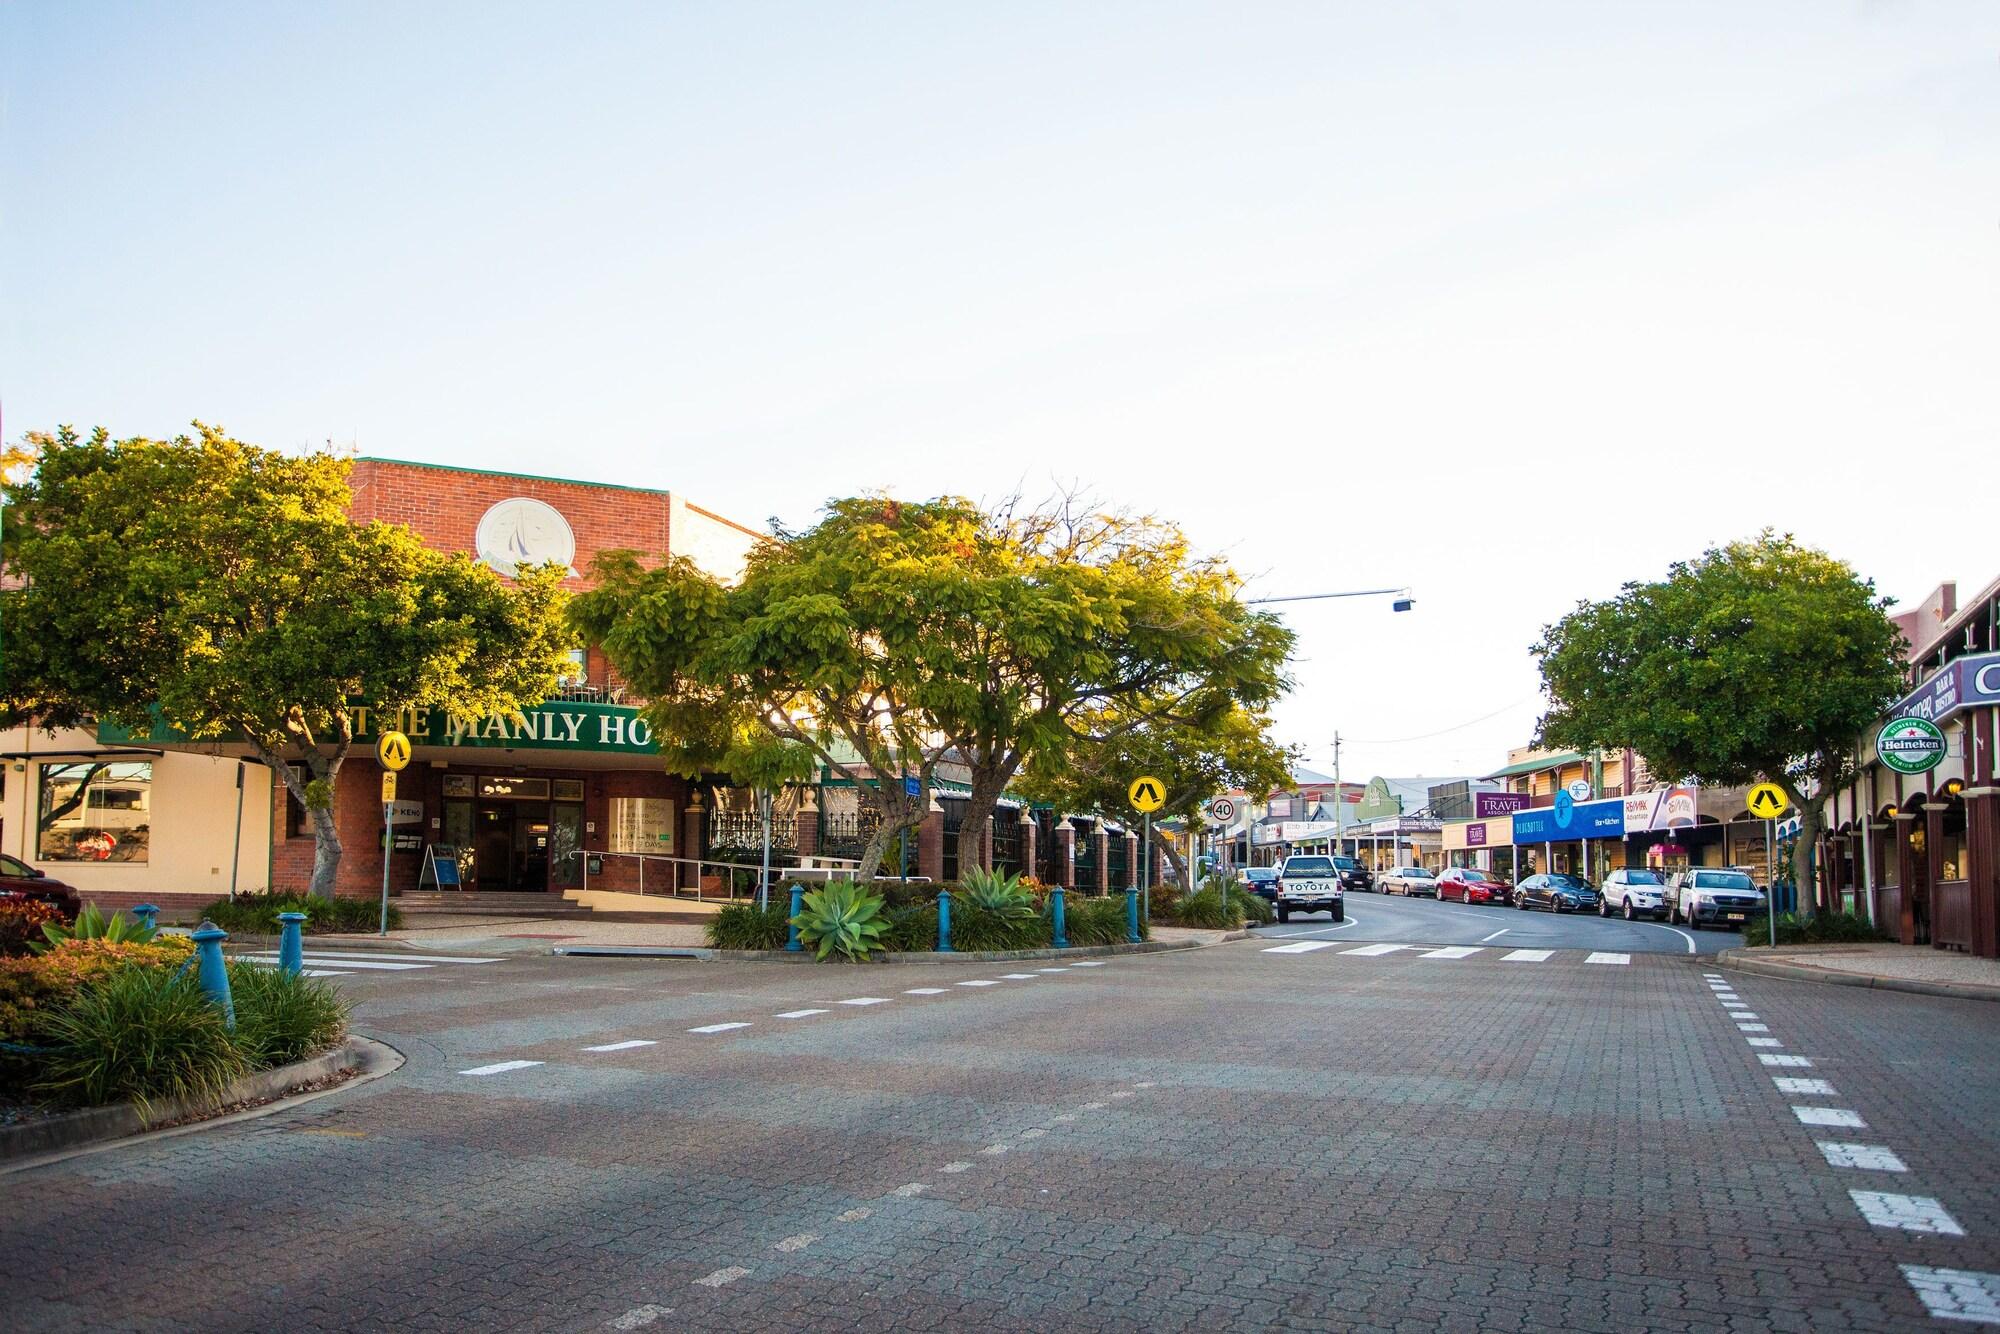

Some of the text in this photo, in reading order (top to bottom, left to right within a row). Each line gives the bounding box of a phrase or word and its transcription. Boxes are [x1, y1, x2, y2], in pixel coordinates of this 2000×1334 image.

[437, 708, 587, 742] MANLY
[1885, 740, 1939, 750] Heineken
[1215, 804, 1231, 815] 40
[1289, 883, 1331, 891] TOYOTA
